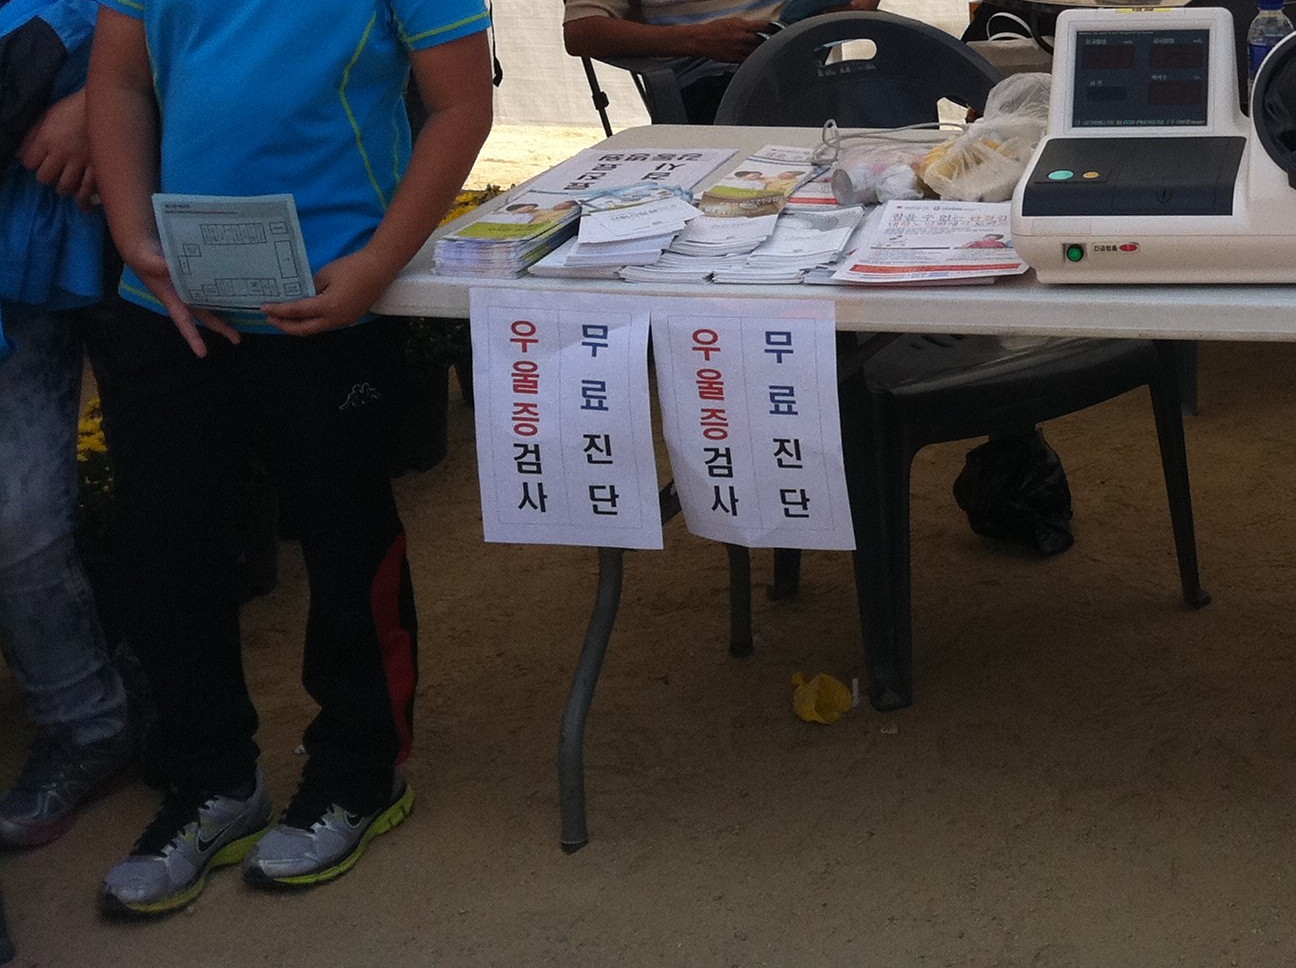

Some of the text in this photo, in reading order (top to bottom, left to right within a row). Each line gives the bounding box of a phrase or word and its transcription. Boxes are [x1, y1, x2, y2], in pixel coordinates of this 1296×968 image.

[509, 320, 549, 515] 우울증검사
[580, 323, 621, 517] 무료진단
[691, 328, 739, 518] 우울증검사
[764, 331, 811, 520] 무료진단
